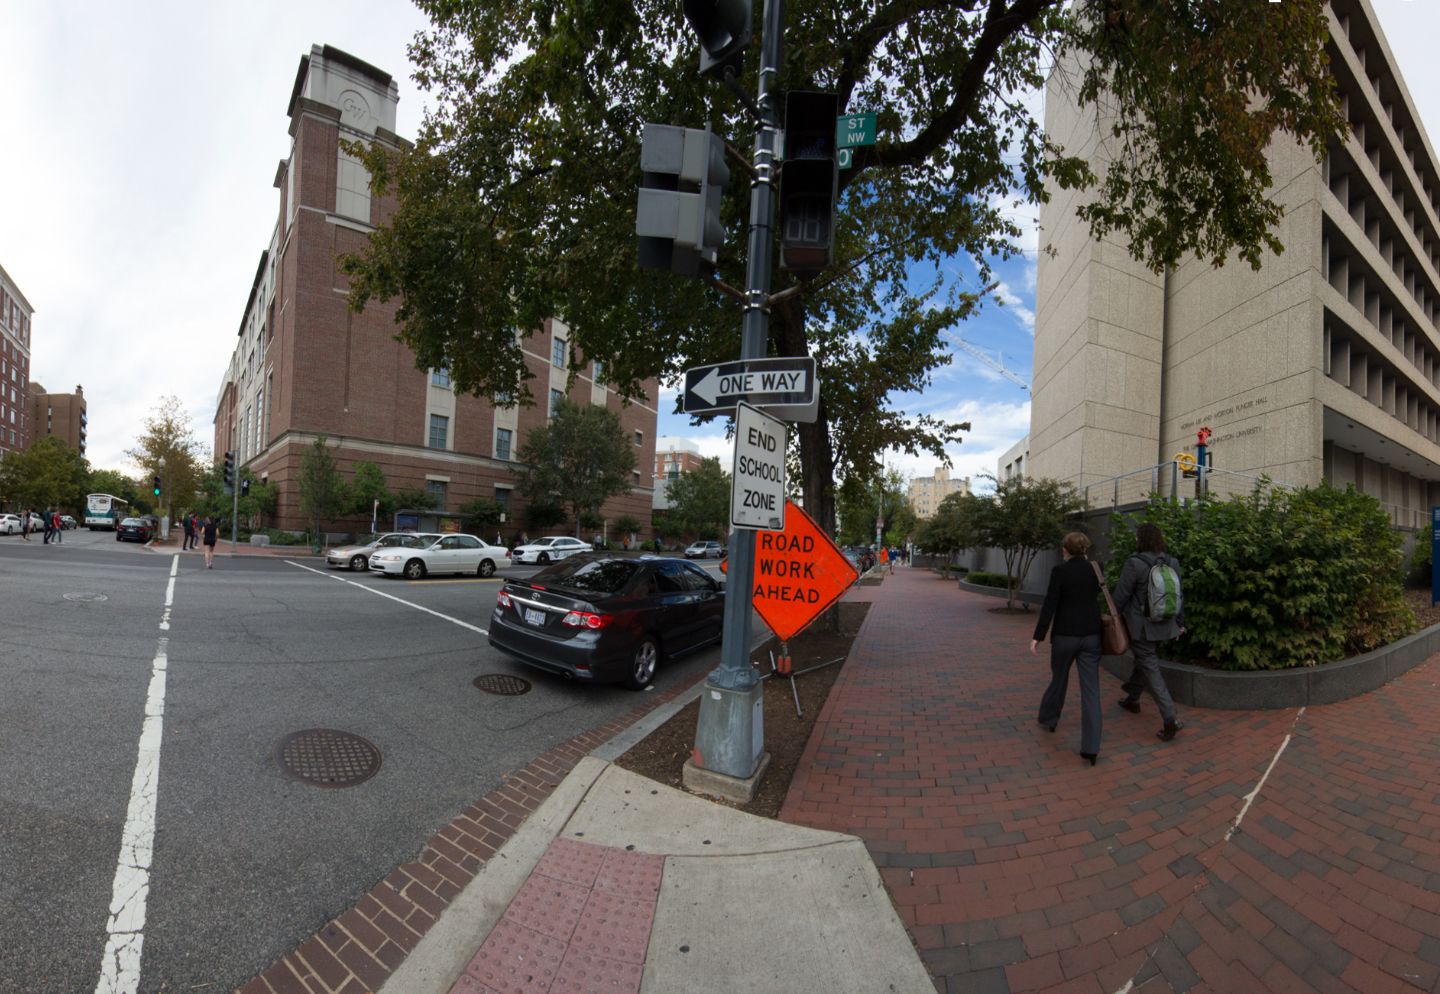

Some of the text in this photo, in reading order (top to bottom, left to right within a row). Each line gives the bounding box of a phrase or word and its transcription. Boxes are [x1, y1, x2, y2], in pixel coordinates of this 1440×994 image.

[847, 117, 866, 129] ST
[847, 131, 866, 144] NW
[719, 372, 801, 394] ONE WAY
[748, 426, 777, 452] END
[739, 456, 782, 484] SCHOOL
[743, 489, 776, 511] ZONE
[762, 533, 815, 553] ROAD
[760, 559, 815, 579] WORK
[753, 584, 820, 604] AHEAD
